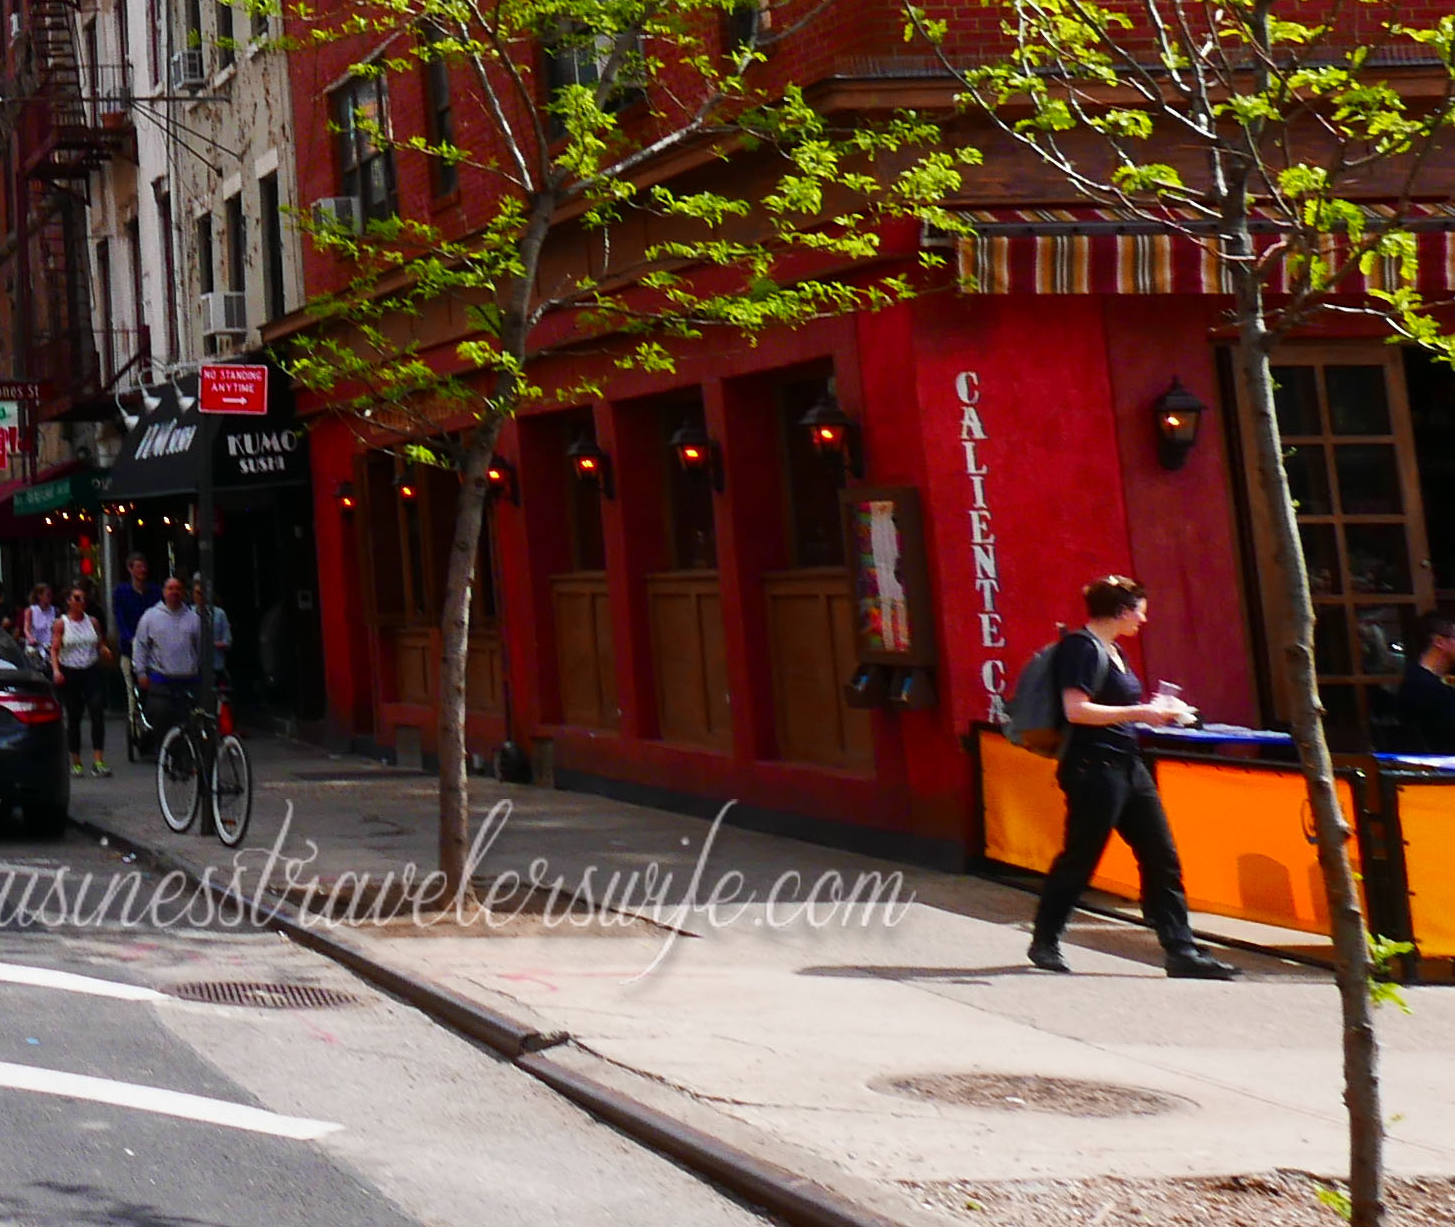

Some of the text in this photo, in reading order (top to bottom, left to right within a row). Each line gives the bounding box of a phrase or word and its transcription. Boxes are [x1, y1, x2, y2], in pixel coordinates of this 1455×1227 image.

[204, 370, 263, 381] NO STANDING
[27, 384, 40, 398] St
[211, 383, 256, 394] ANYTIME
[226, 429, 298, 456] KUMO
[240, 456, 286, 474] SUSHI
[955, 371, 1006, 647] CALIENTE
